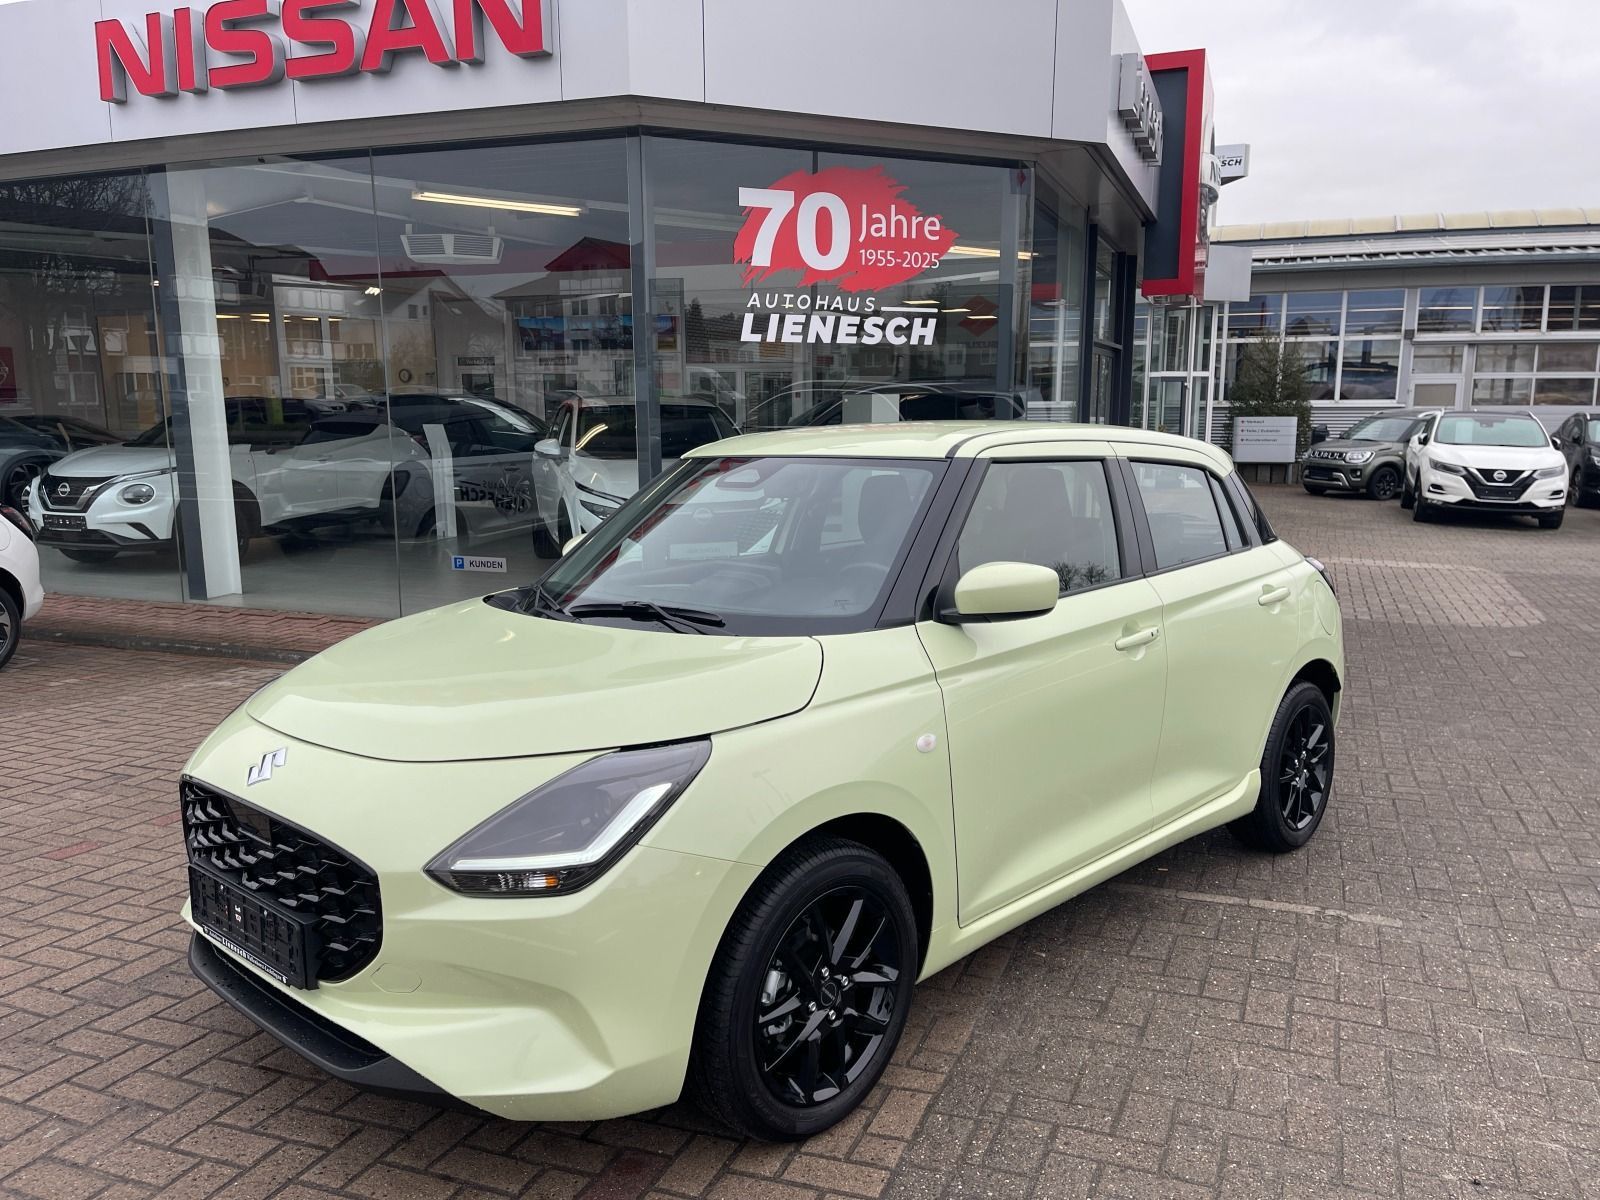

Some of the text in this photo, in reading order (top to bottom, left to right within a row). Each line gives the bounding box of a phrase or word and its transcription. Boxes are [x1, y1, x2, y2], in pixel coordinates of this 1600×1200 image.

[94, 0, 551, 103] NISSAN
[1220, 158, 1243, 167] SCH
[738, 186, 941, 271] 70 Jahre
[858, 248, 940, 269] 1955-2025
[747, 292, 876, 312] AUTOHAUS
[740, 312, 937, 346] LIENESCH
[469, 559, 503, 569] KUNDEN
